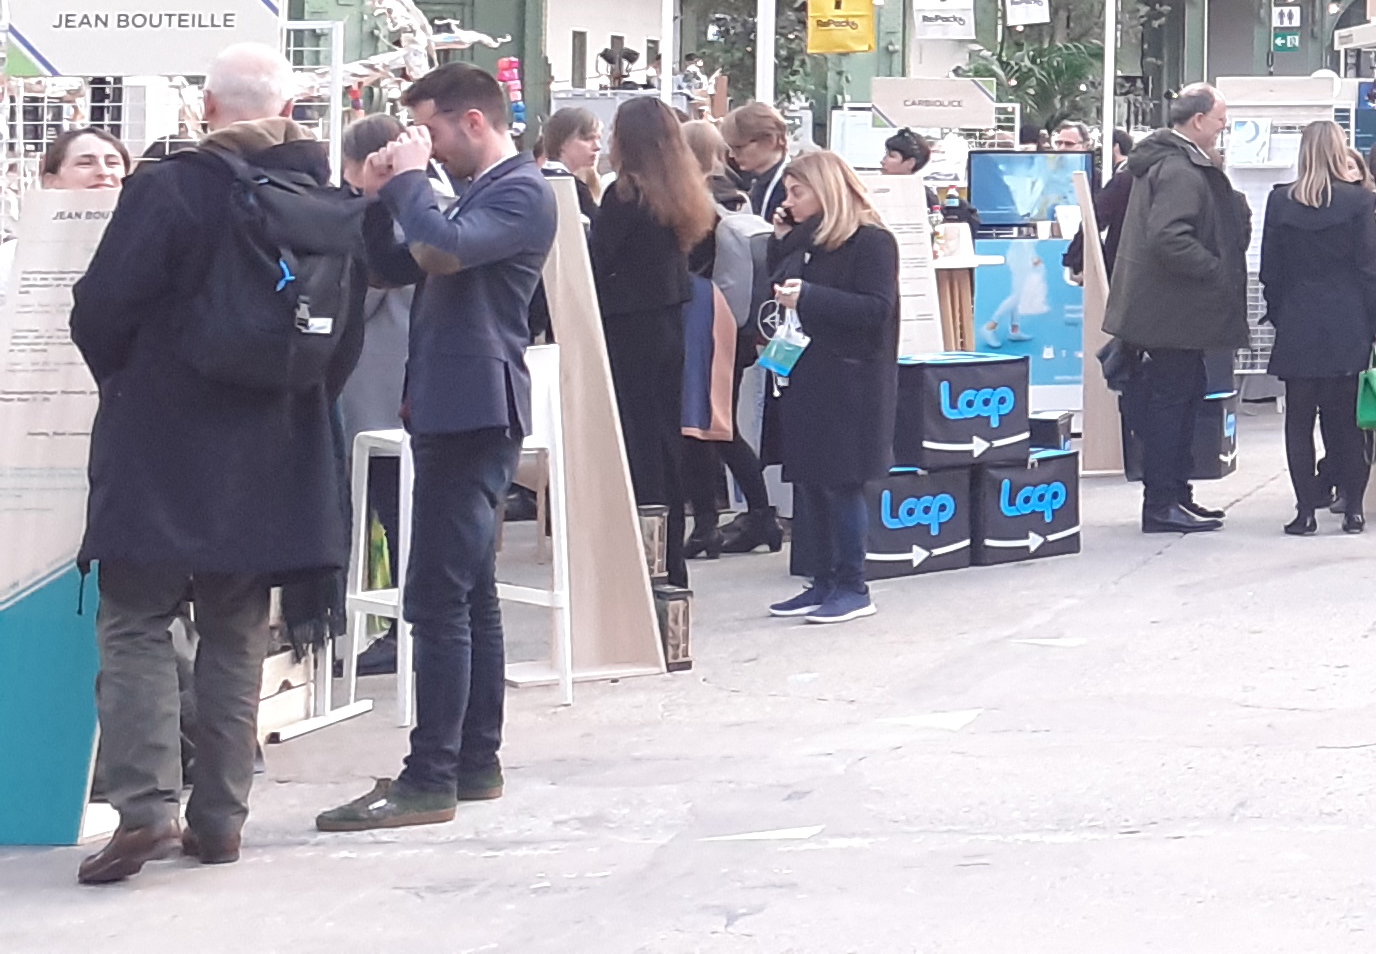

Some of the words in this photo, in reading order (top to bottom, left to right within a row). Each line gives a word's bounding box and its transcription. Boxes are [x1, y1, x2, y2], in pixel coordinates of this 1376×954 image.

[52, 13, 109, 28] JEAN
[117, 13, 236, 28] BOUTEILLE
[939, 380, 1015, 428] Loop
[881, 489, 956, 536] Loop
[1000, 478, 1067, 523] Loop
